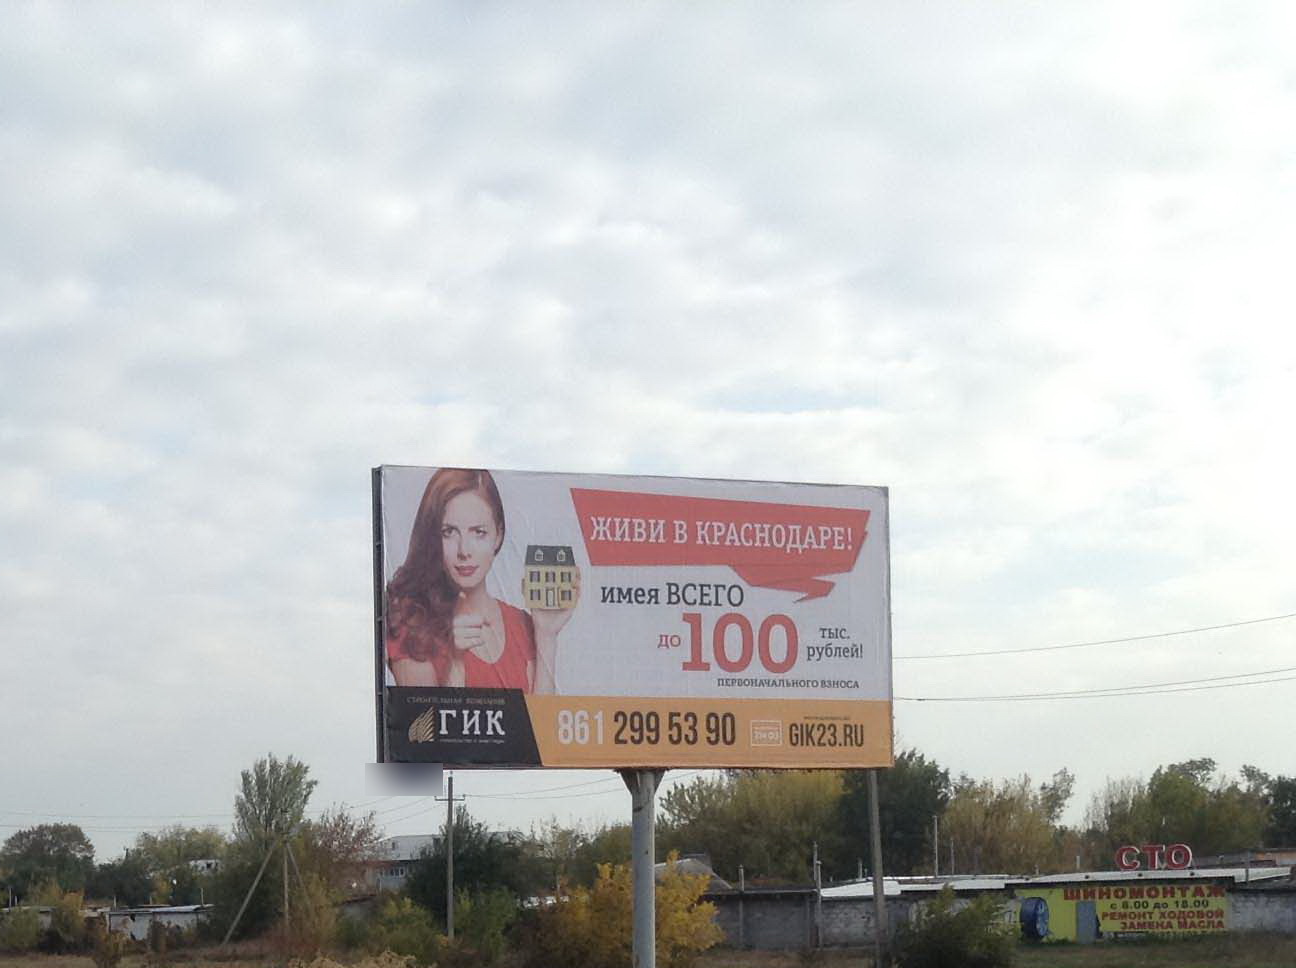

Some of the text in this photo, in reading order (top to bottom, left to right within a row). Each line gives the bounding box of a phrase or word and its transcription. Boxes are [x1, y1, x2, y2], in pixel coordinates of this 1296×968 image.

[589, 516, 853, 554] ЖИВИ В КРАСНОДАРЕ!
[600, 582, 744, 607] имея ВСЕГО
[657, 612, 799, 673] до 100
[819, 628, 850, 640] тыс.
[806, 644, 863, 662] рублей!
[717, 678, 859, 689] ПЕРВОНАЧАЛЬНОГО ВЗНОСА
[439, 709, 505, 735] ГИК
[558, 710, 603, 745] 861
[614, 711, 660, 745] 299
[668, 711, 698, 745] 53
[706, 712, 736, 746] 90
[789, 723, 864, 747] GIK23.RU
[1115, 843, 1193, 871] СТО
[1064, 885, 1226, 900] ШИНОМОНТАЖ
[1102, 908, 1224, 921] РЕМОНТ ХОДОВОЙ
[1153, 902, 1168, 910] до
[1120, 920, 1225, 930] ЗАМЕНА МАСЛА
